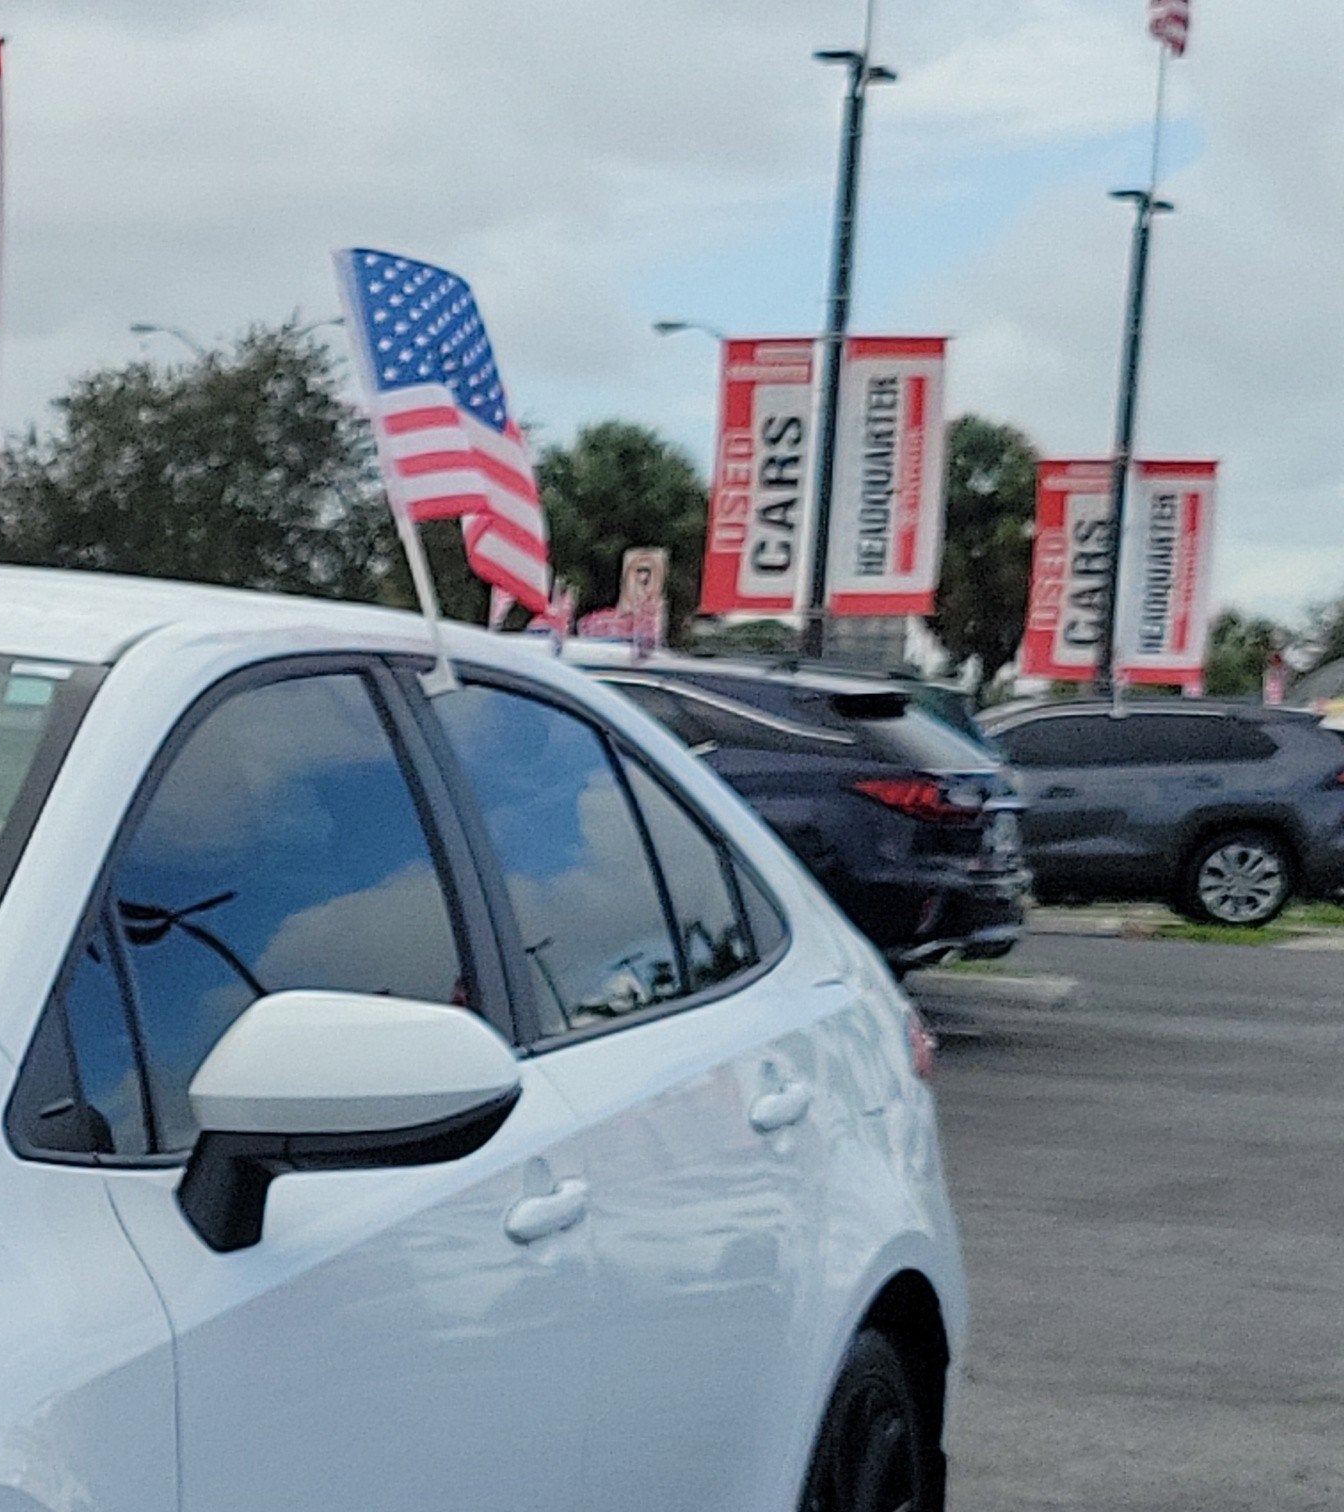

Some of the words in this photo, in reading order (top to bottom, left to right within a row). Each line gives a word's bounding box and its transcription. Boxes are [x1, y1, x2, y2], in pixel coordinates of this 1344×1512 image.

[715, 435, 754, 546] USED
[752, 414, 803, 576] CARS
[1064, 518, 1111, 645] CARS
